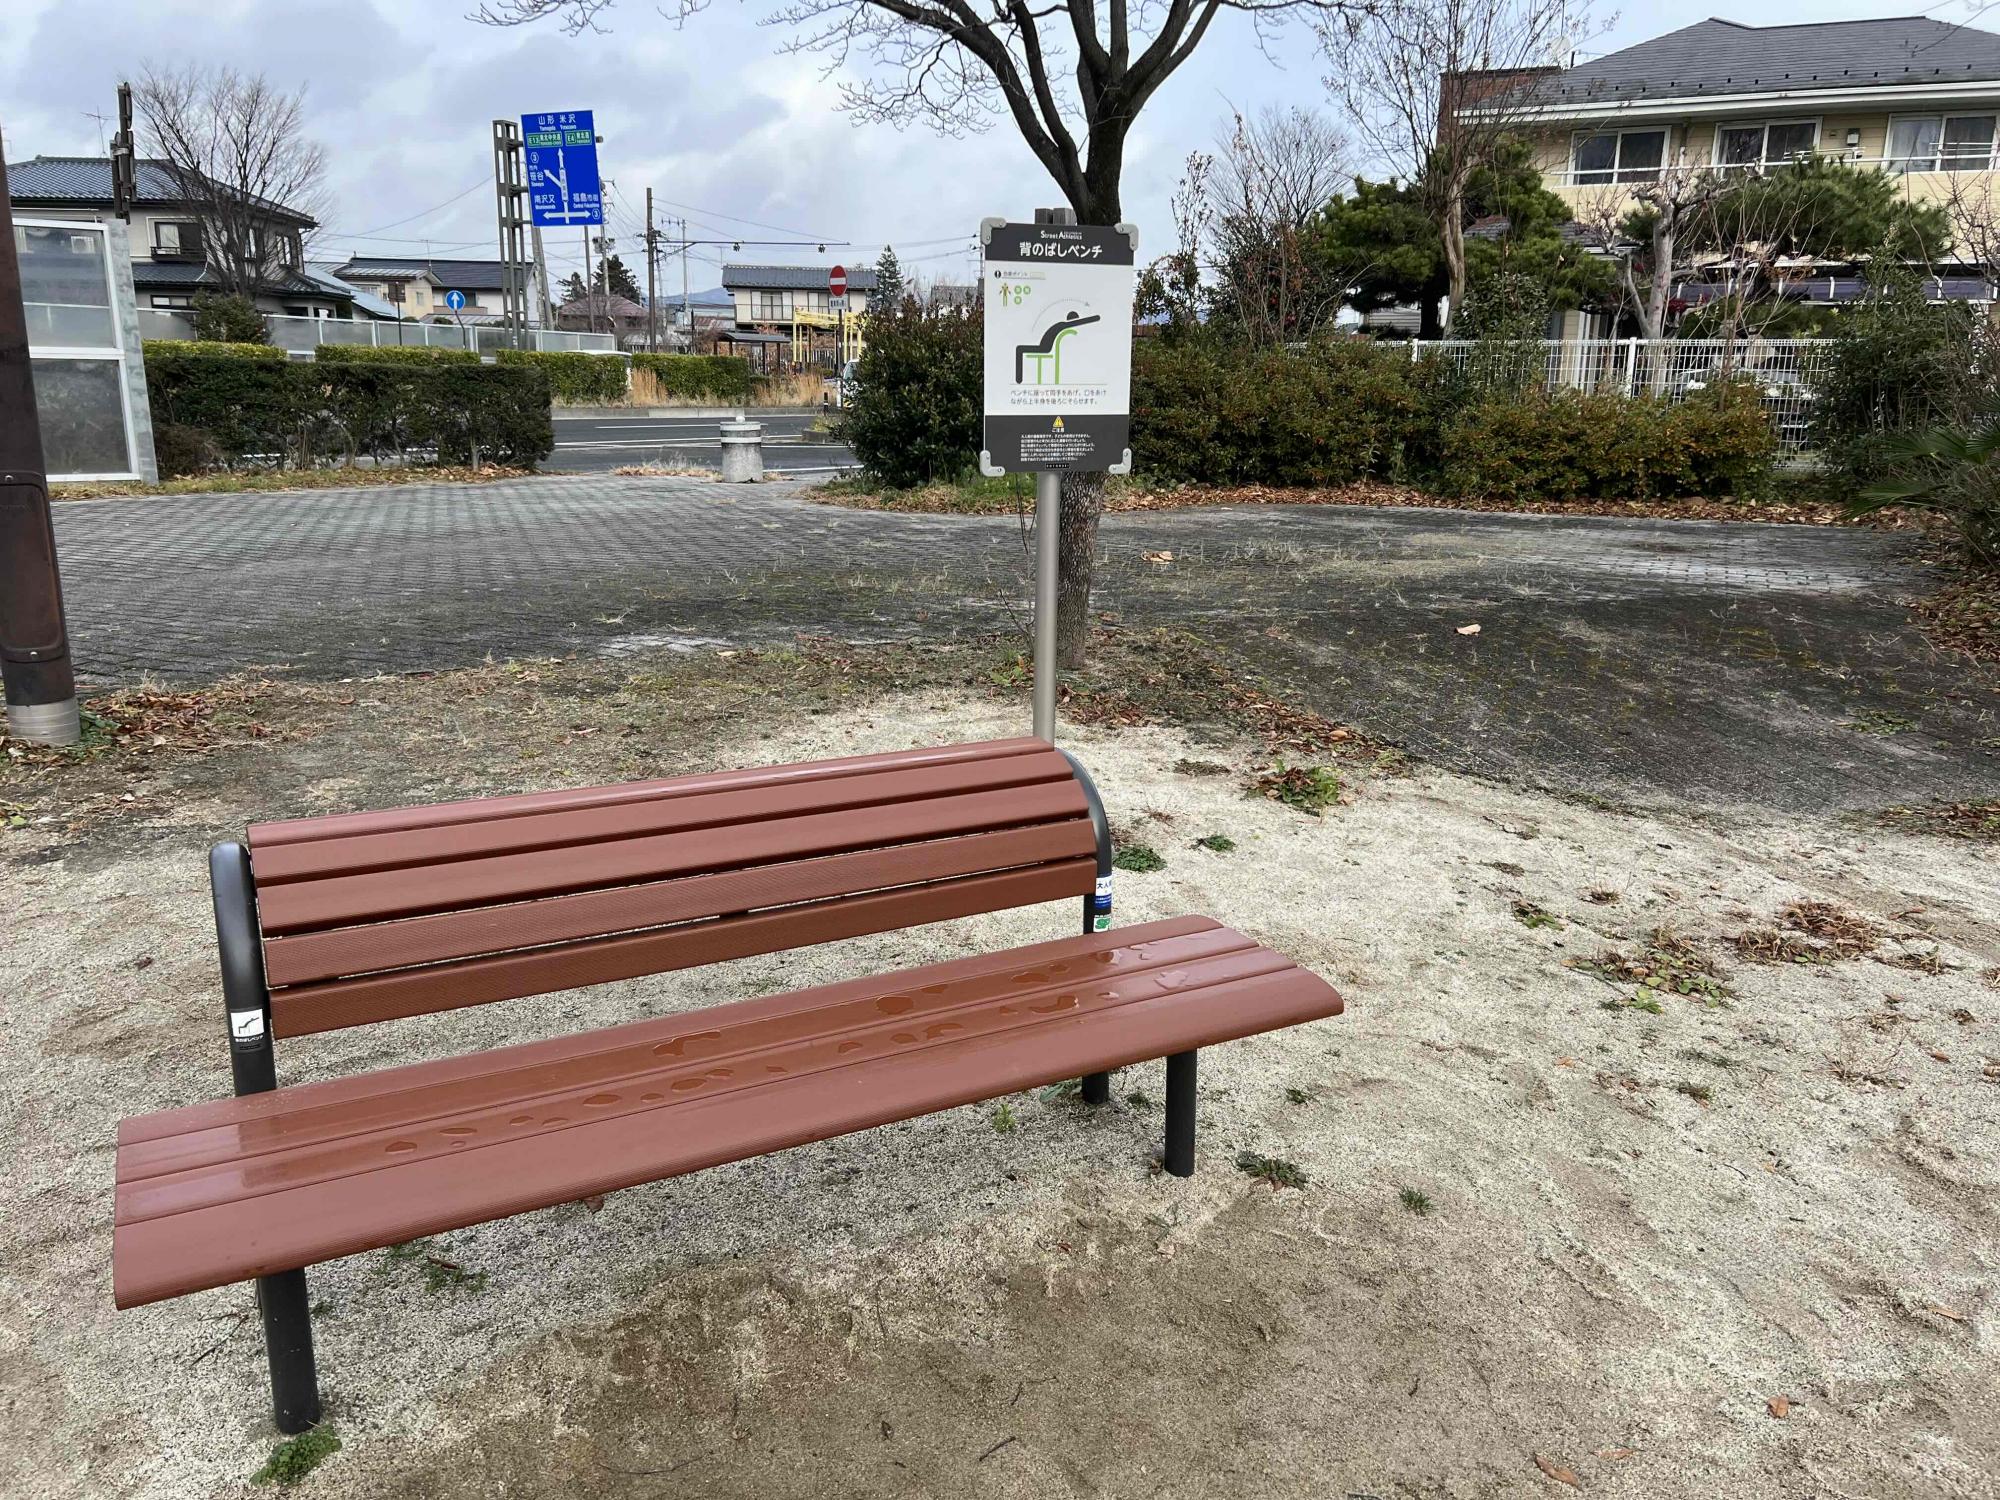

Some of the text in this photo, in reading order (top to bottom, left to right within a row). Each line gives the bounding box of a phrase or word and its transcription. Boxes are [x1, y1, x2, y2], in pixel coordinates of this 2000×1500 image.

[538, 113, 576, 125] 山形 米沢
[1019, 241, 1102, 258] 背のばしベンチ
